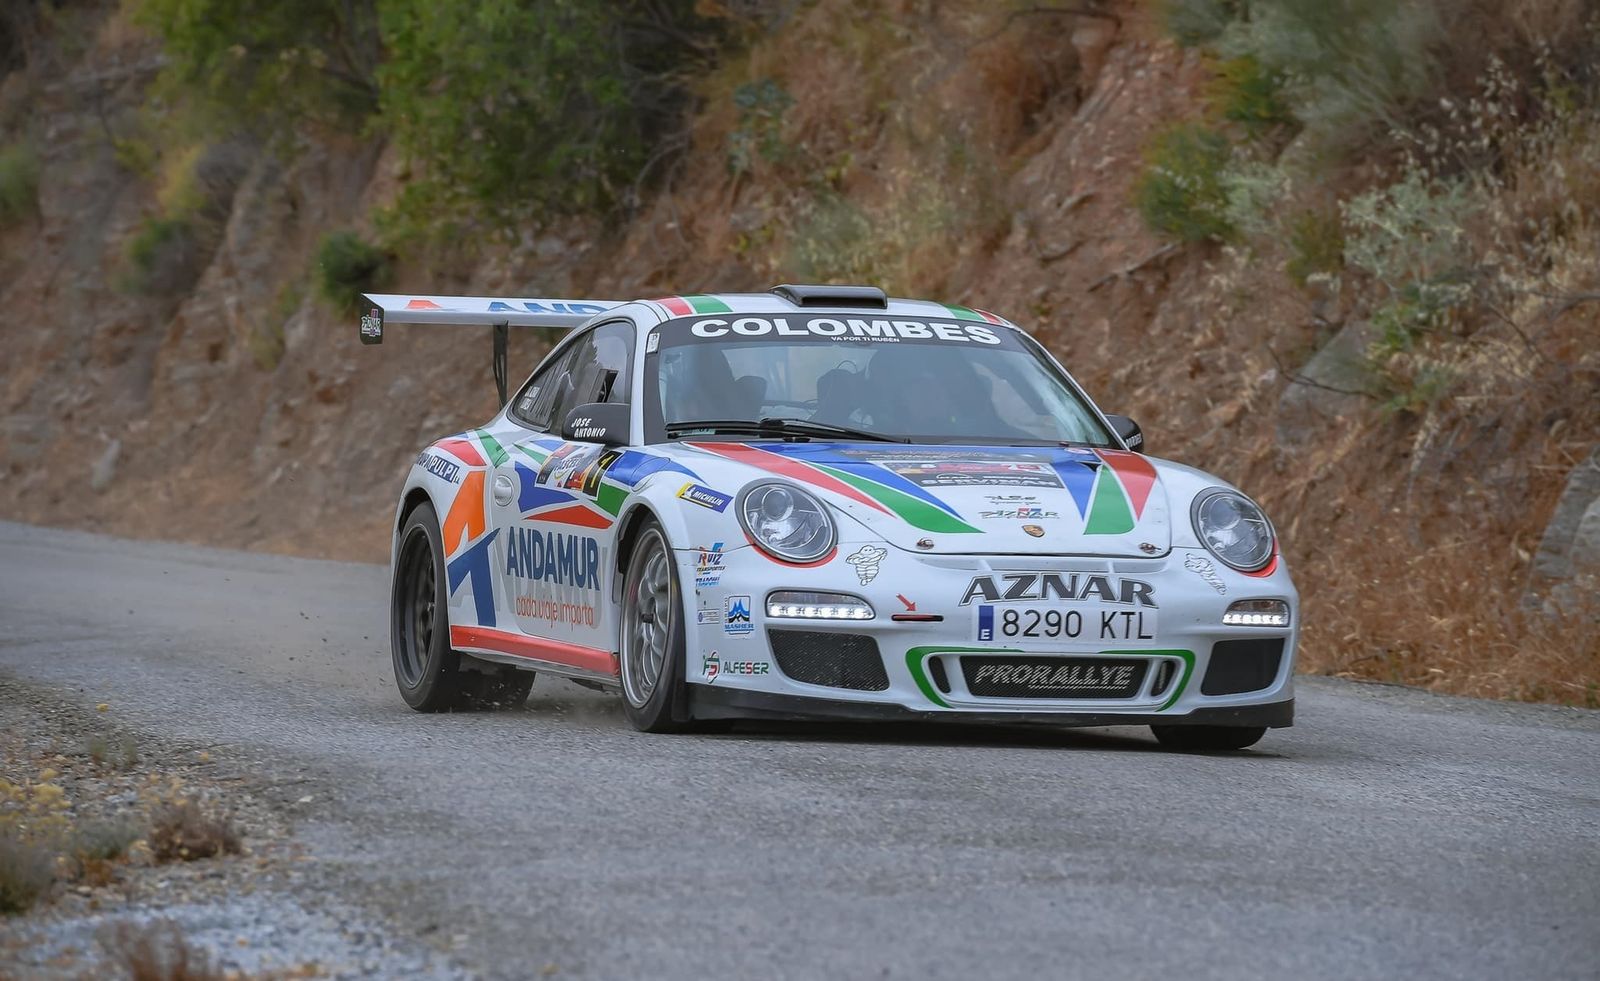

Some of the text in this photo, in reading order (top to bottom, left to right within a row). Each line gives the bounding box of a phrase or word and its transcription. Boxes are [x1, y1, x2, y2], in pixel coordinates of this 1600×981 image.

[691, 317, 1001, 345] COLOMBES
[571, 417, 592, 428] JOSE
[573, 427, 606, 438] ANTONIO
[693, 490, 725, 506] MICHELIN
[506, 526, 600, 591] ANDAMUR
[958, 574, 1159, 609] AZNAR
[560, 603, 594, 632] importa
[1002, 609, 1153, 639] 8290 KTL
[723, 661, 769, 675] ALFESER
[975, 665, 1134, 684] PRORALLYE
